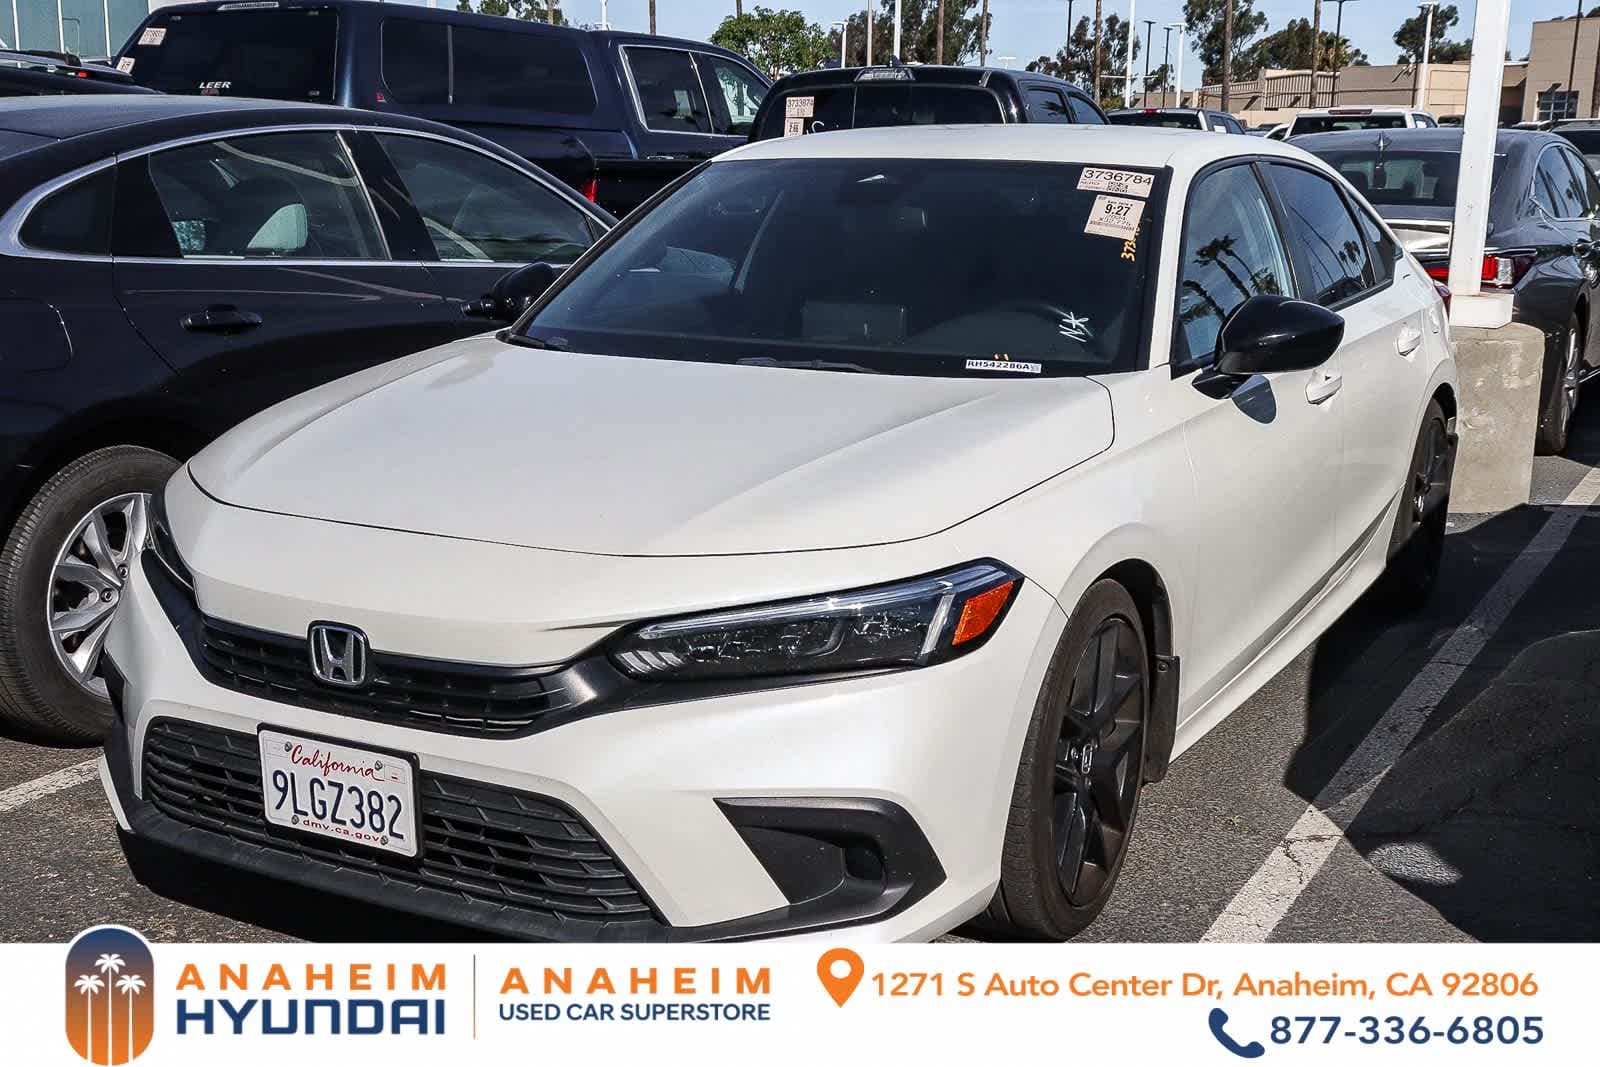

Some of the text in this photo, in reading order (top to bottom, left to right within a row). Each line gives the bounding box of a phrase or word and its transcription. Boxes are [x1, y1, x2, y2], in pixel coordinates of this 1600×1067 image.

[199, 81, 232, 89] LEER
[1084, 169, 1152, 185] 3736784
[1105, 203, 1131, 217] 9:27
[291, 744, 385, 782] California
[272, 769, 404, 840] 9LGZ382
[302, 819, 380, 843] dmv.ca.gov
